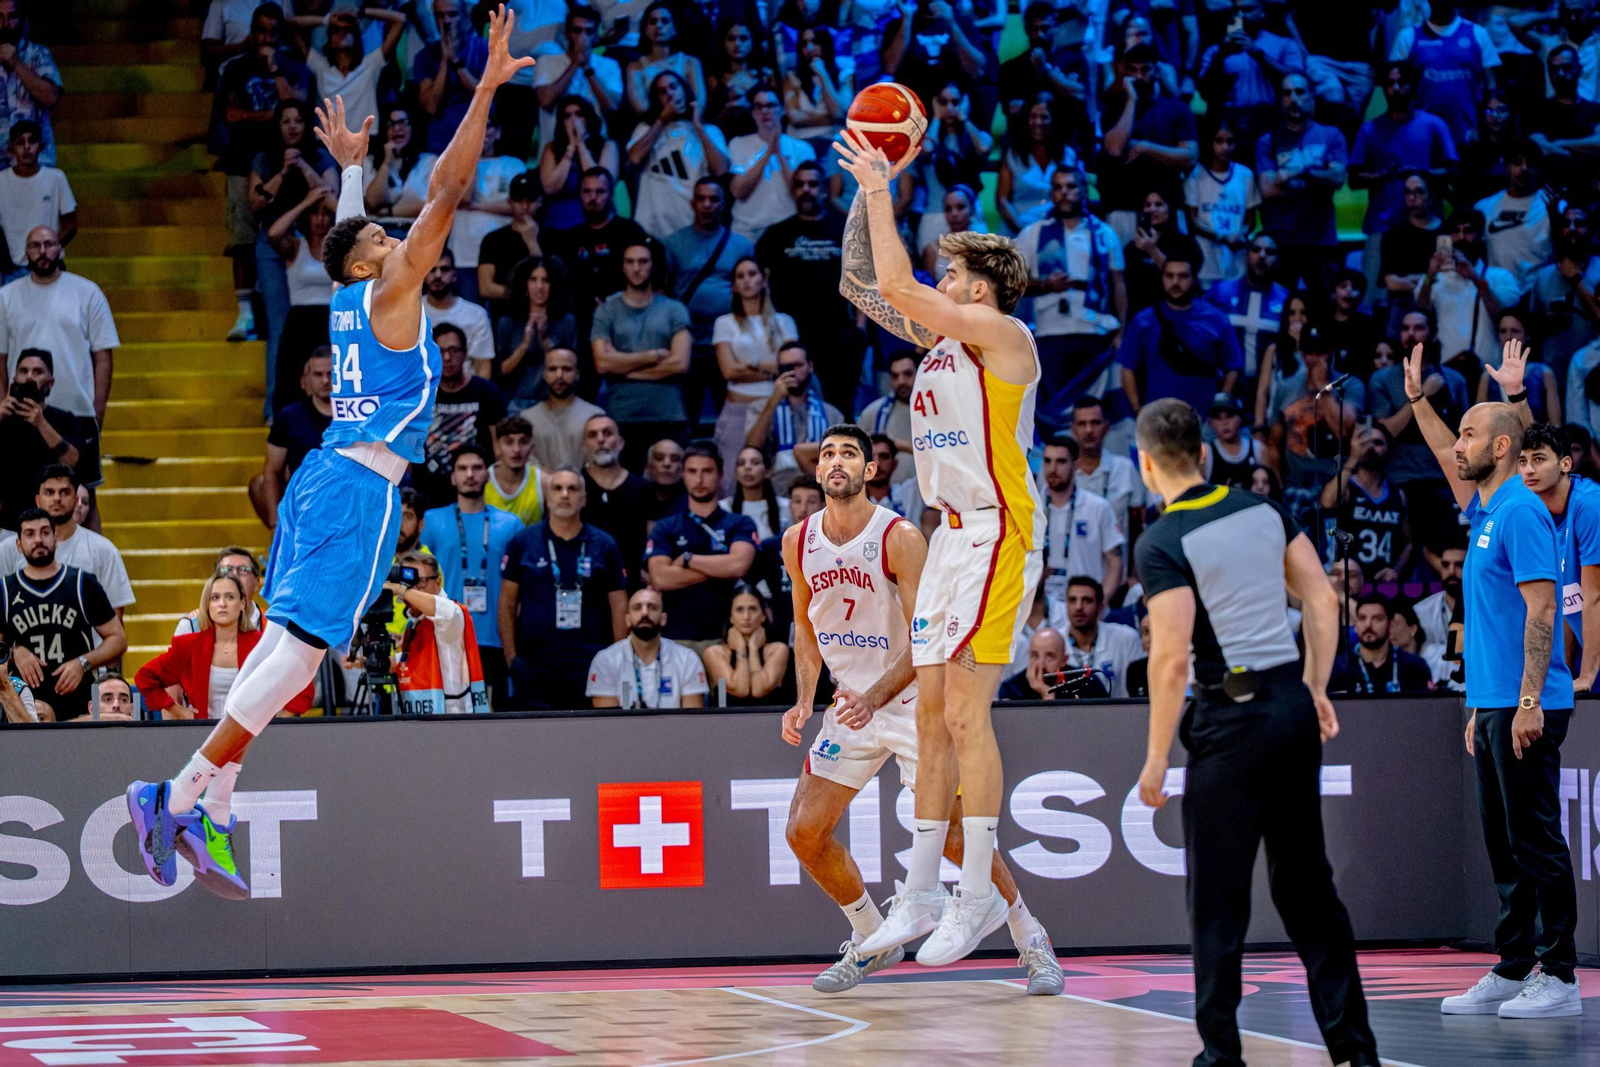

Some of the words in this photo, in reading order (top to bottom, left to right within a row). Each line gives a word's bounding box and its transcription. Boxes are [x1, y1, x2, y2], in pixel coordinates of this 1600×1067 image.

[332, 343, 363, 394] 34
[335, 399, 379, 418] EKO
[914, 389, 939, 417] 41
[913, 429, 970, 451] edesa
[1357, 528, 1392, 563] 34
[811, 566, 876, 593] ESPAÑA
[12, 603, 78, 635] BUCKS
[843, 598, 856, 621] 7
[30, 633, 65, 664] 34
[818, 630, 889, 650] endesa
[494, 798, 570, 877] T
